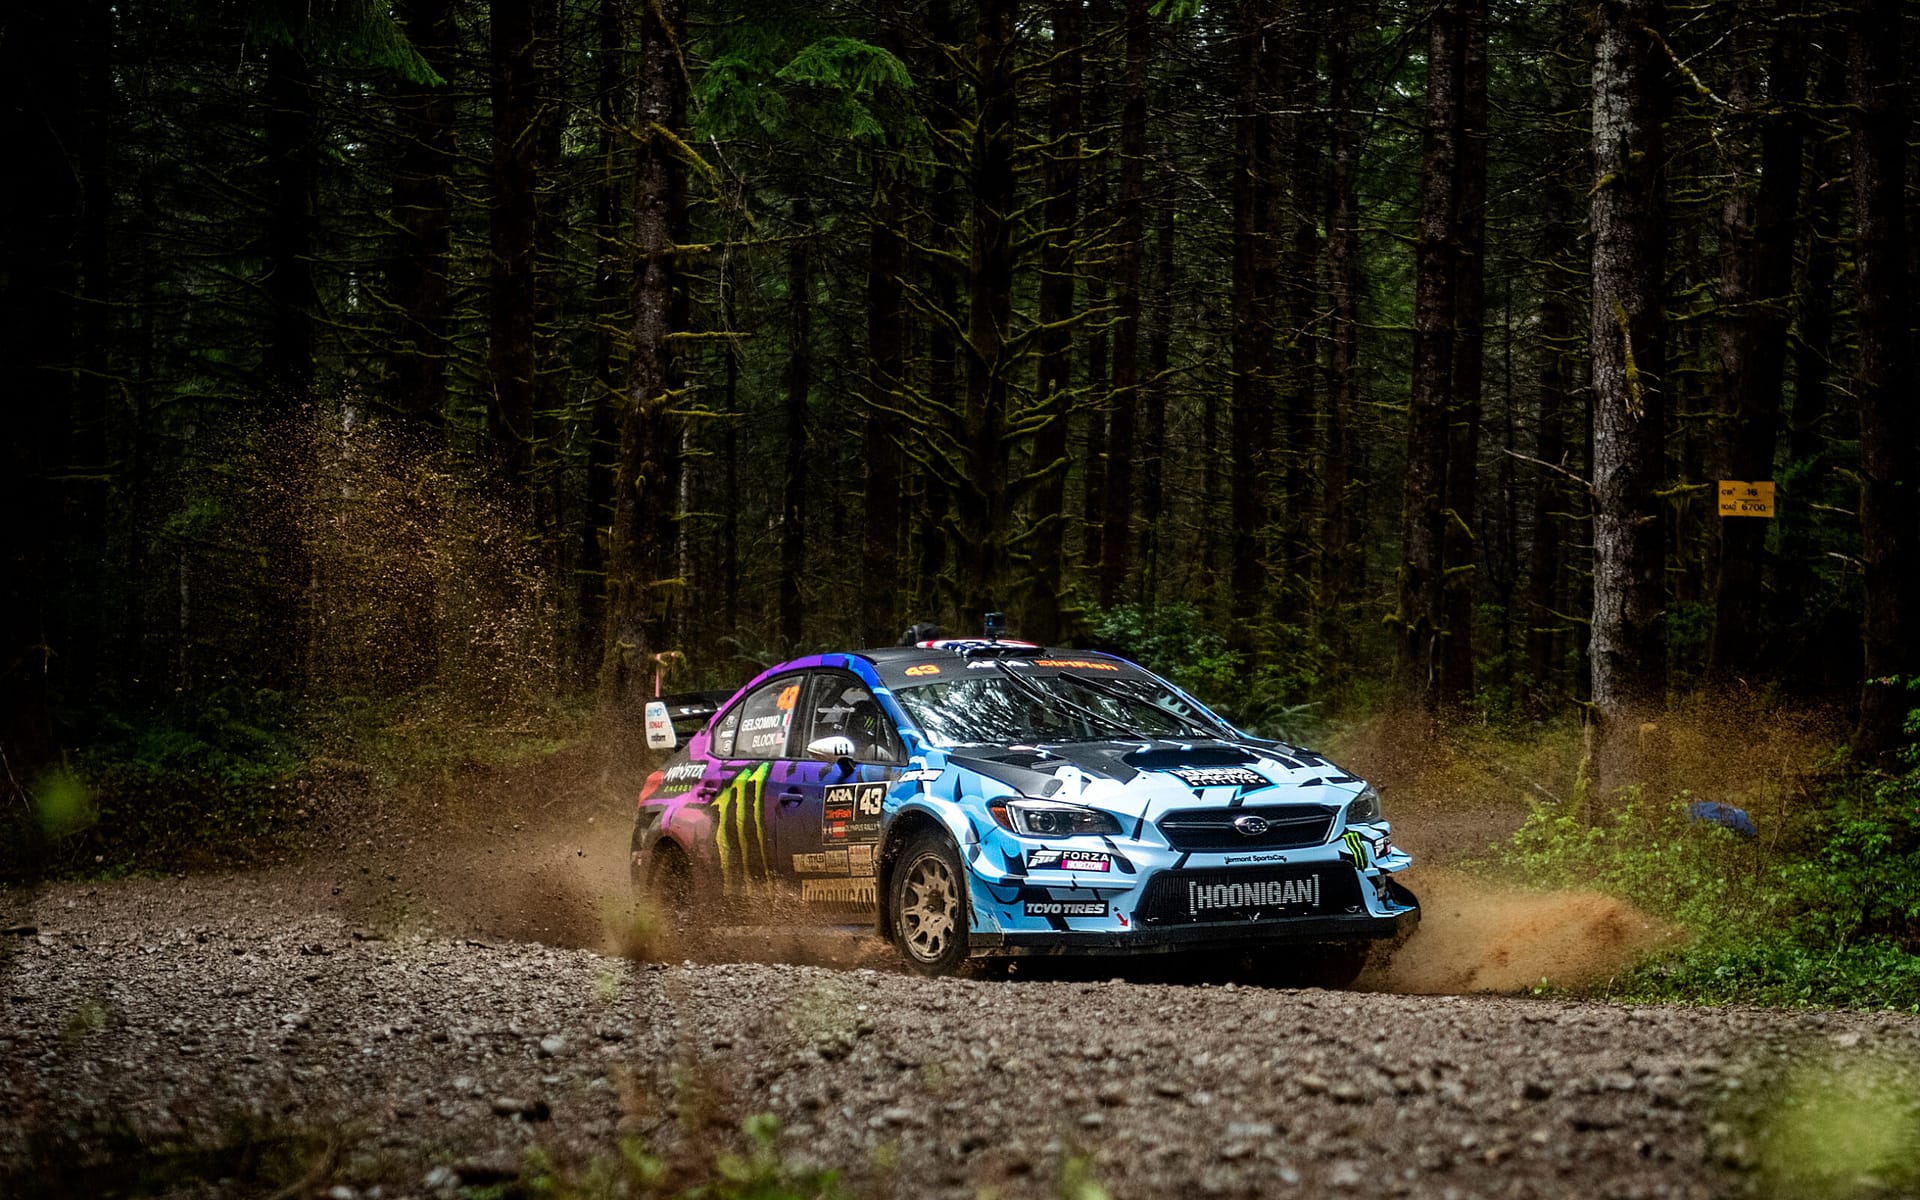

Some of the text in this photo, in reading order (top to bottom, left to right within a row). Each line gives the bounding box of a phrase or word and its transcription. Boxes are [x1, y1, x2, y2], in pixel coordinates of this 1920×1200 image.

[1741, 503, 1766, 511] 6700
[905, 664, 940, 677] 43
[776, 685, 799, 710] 43
[741, 715, 780, 732] GELSOMINO
[751, 733, 776, 748] BLOCK
[663, 784, 693, 793] ENERGY
[826, 789, 853, 802] ARA
[859, 788, 882, 815] 43
[1062, 851, 1110, 862] FORZA
[1224, 854, 1287, 865] Vermont SportsCar
[1066, 860, 1103, 871] HORIZON
[1026, 903, 1106, 914] TOYO TIRES
